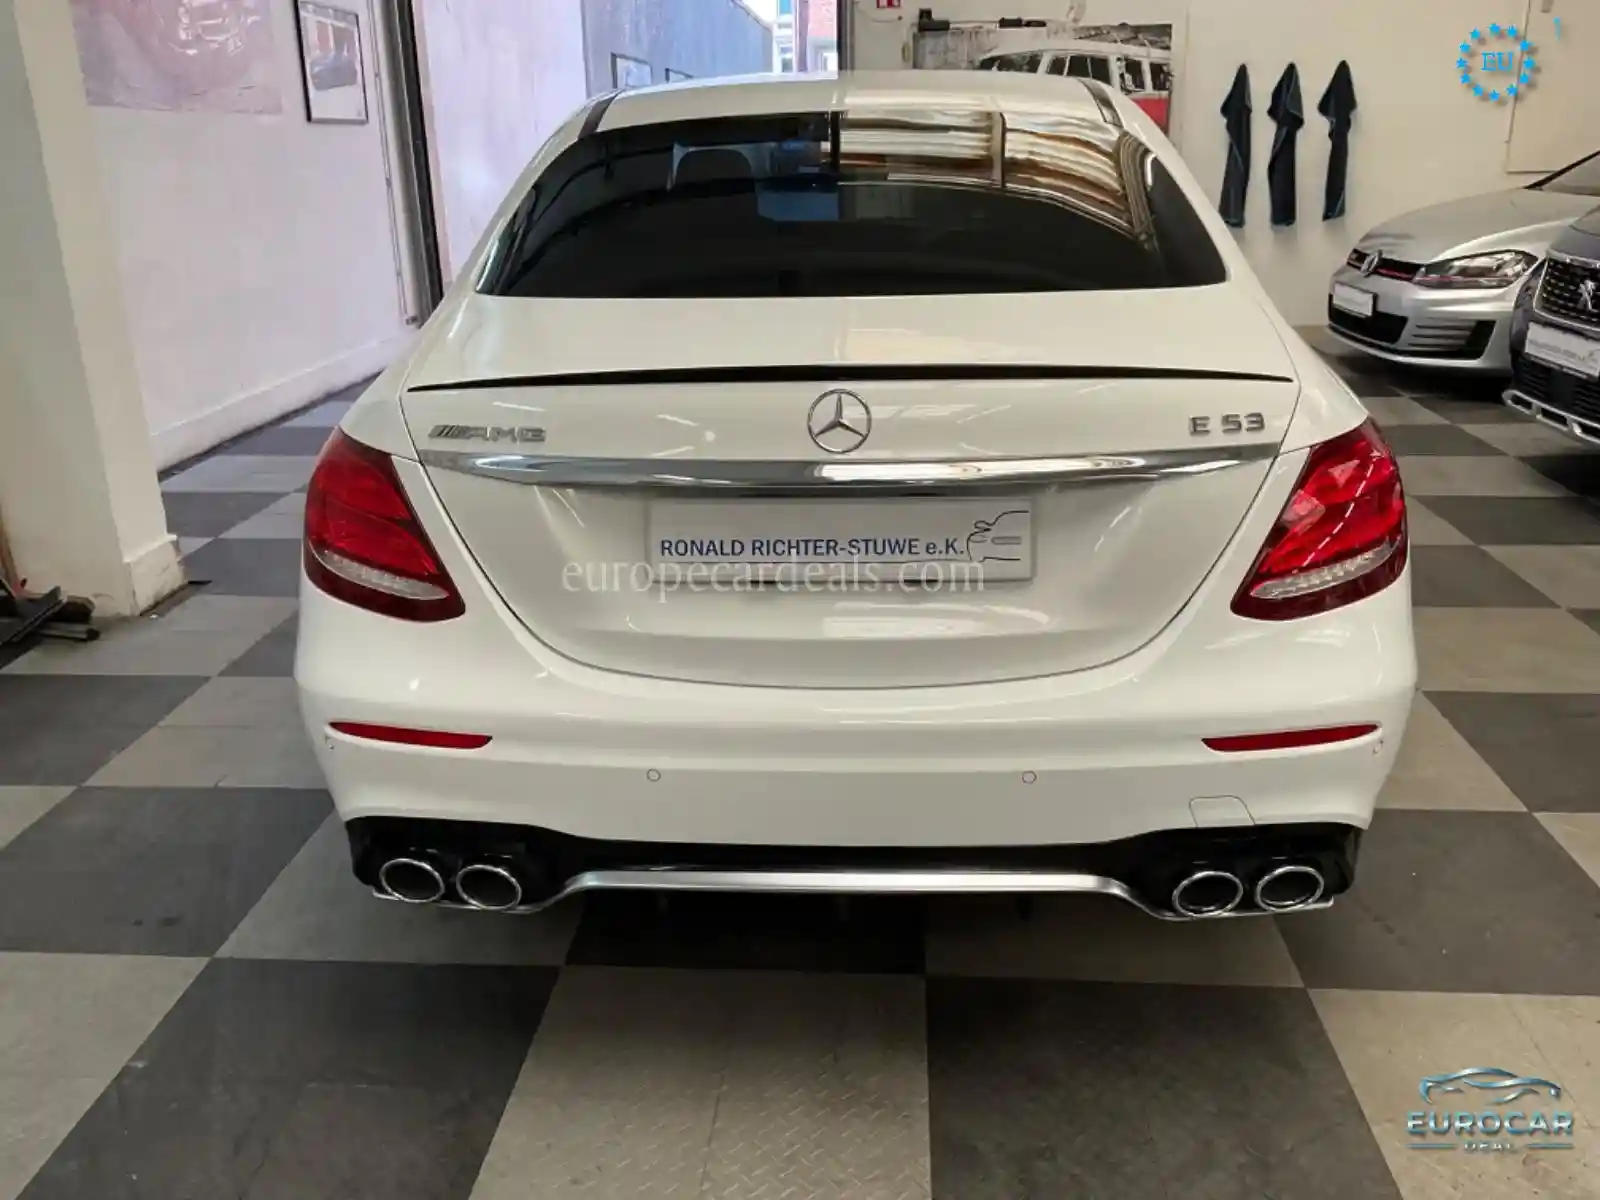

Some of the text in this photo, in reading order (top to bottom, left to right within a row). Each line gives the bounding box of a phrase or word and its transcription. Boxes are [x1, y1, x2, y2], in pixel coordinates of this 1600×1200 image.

[1189, 411, 1265, 436] E 53
[660, 537, 964, 557] RONALD RICHTER-STUWE e.K.
